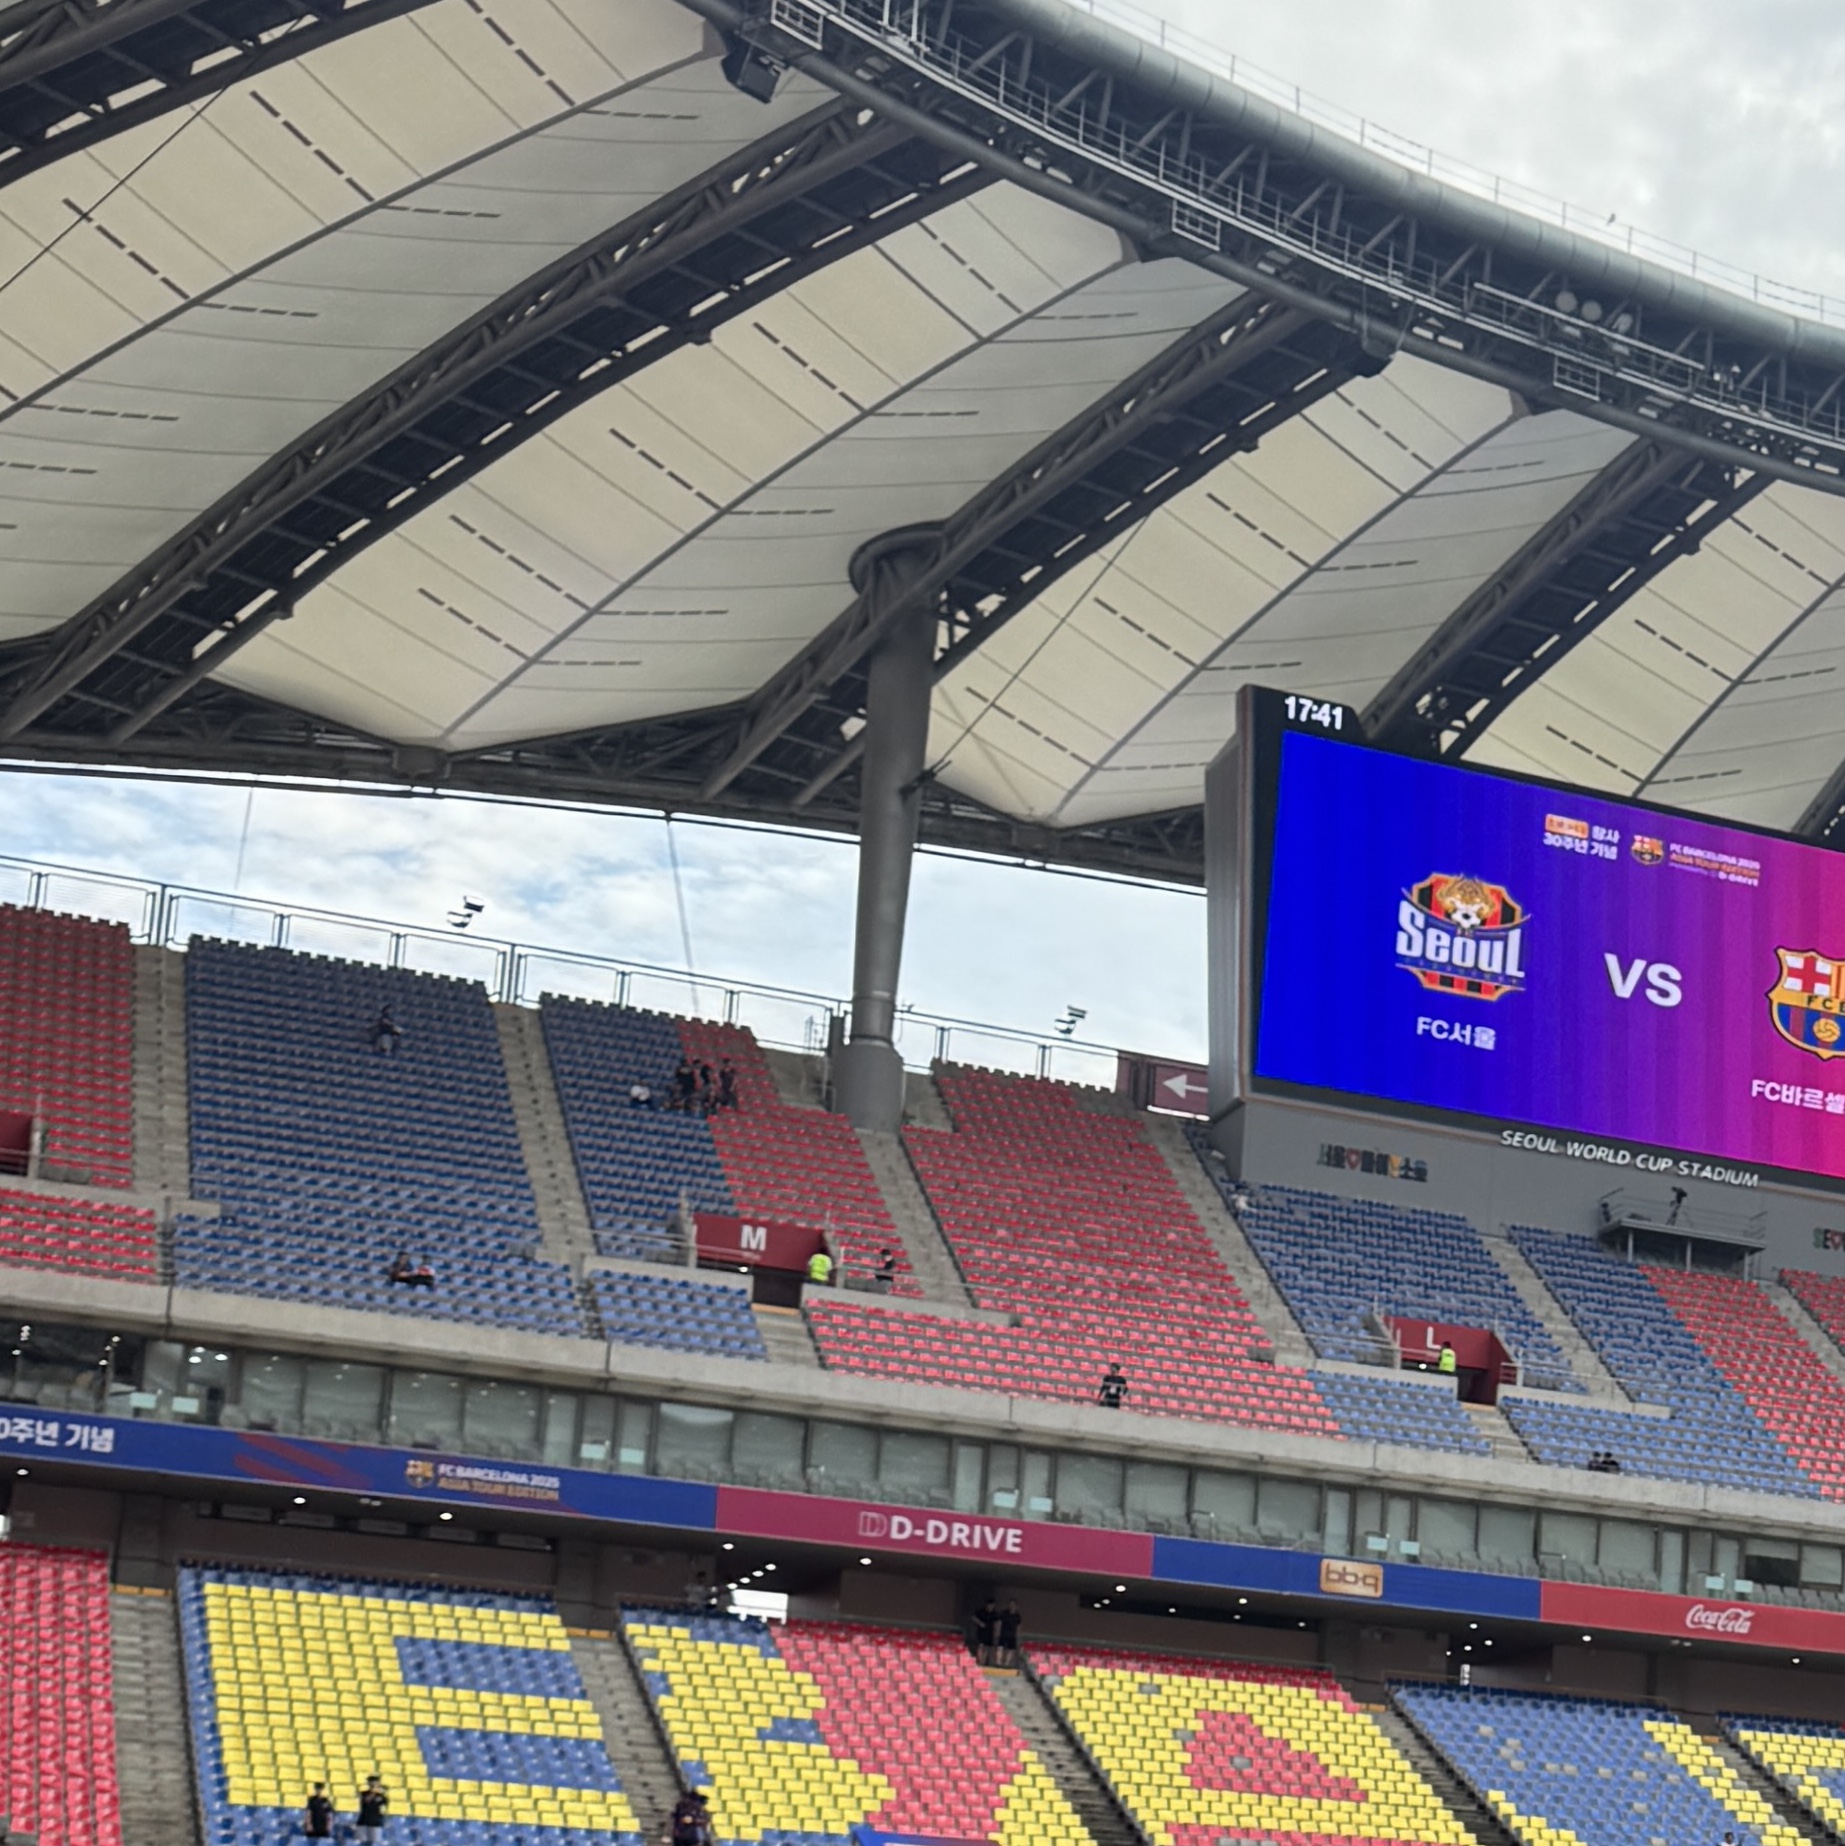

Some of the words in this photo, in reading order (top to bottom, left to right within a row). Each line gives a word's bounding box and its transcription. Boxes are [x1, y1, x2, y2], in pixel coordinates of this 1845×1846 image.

[1284, 695, 1343, 731] 17:41
[1396, 900, 1526, 978] Seoul
[1604, 952, 1683, 1007] VS
[1416, 1016, 1497, 1051] FC서울
[1500, 1129, 1558, 1154] SEOUL
[1566, 1140, 1632, 1167] WORLD
[1635, 1153, 1674, 1173] CUP
[1678, 1159, 1761, 1187] STADIUM
[740, 1224, 767, 1252] M
[1426, 1326, 1441, 1350] L
[65, 1423, 115, 1453] 기념
[889, 1515, 1023, 1553] D-DRIVE
